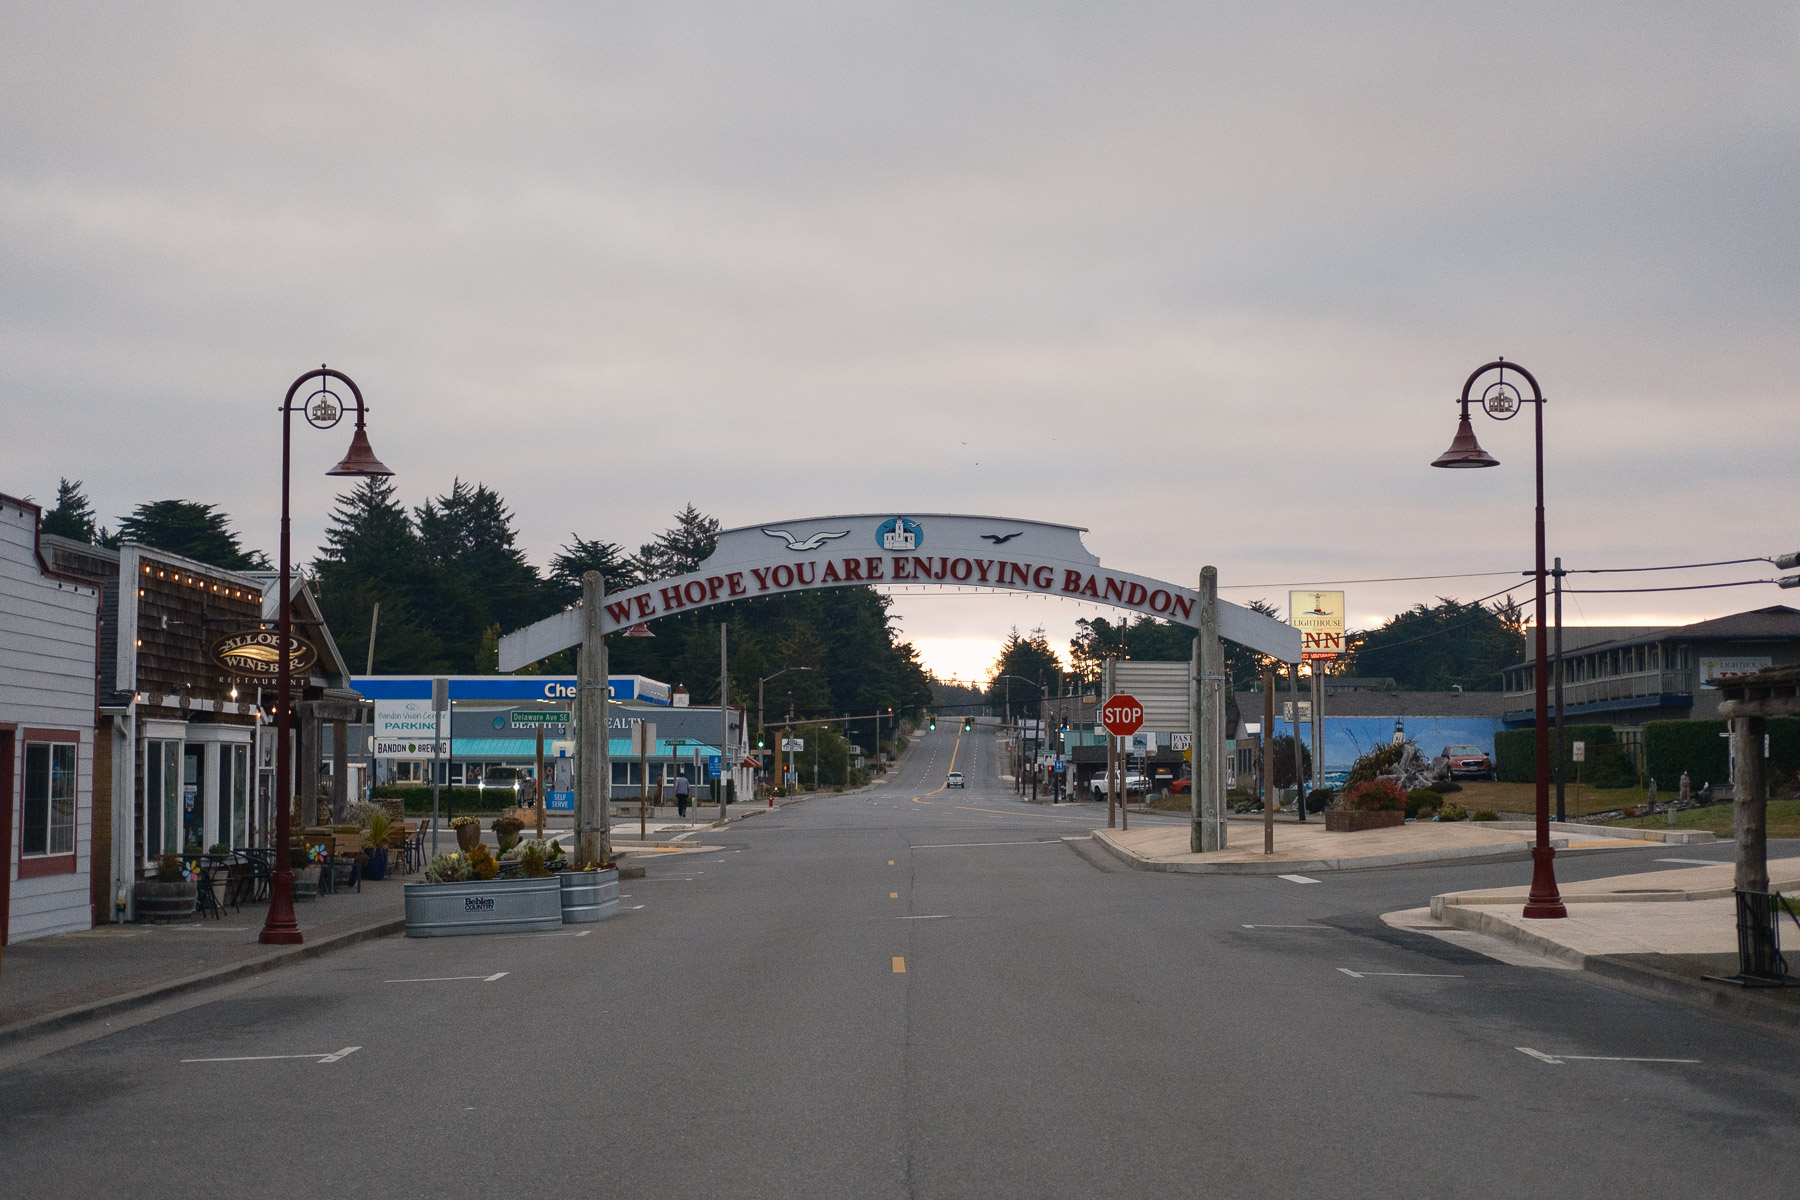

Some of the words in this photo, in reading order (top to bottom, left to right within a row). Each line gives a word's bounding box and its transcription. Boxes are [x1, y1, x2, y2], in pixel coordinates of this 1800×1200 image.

[604, 592, 656, 625] WE
[658, 572, 747, 611] HOPE
[750, 561, 817, 591] YOU
[821, 556, 884, 583] ARE
[891, 556, 1054, 589] ENJOYING
[1061, 568, 1197, 620] BANDON
[1293, 619, 1343, 627] LIGHTHOUSE
[1301, 632, 1342, 649] NN
[219, 677, 305, 686] RESTAURNT
[544, 682, 616, 698] Chen
[377, 711, 402, 720] Bandon
[402, 711, 422, 720] Vision
[513, 713, 544, 721] Delaware
[545, 713, 559, 721] Ave
[559, 713, 568, 721] SE
[1105, 707, 1142, 724] STOP
[377, 743, 407, 754] BANDON
[553, 793, 567, 801] SELF
[551, 800, 569, 808] SERVE
[465, 897, 494, 906] Behlen
